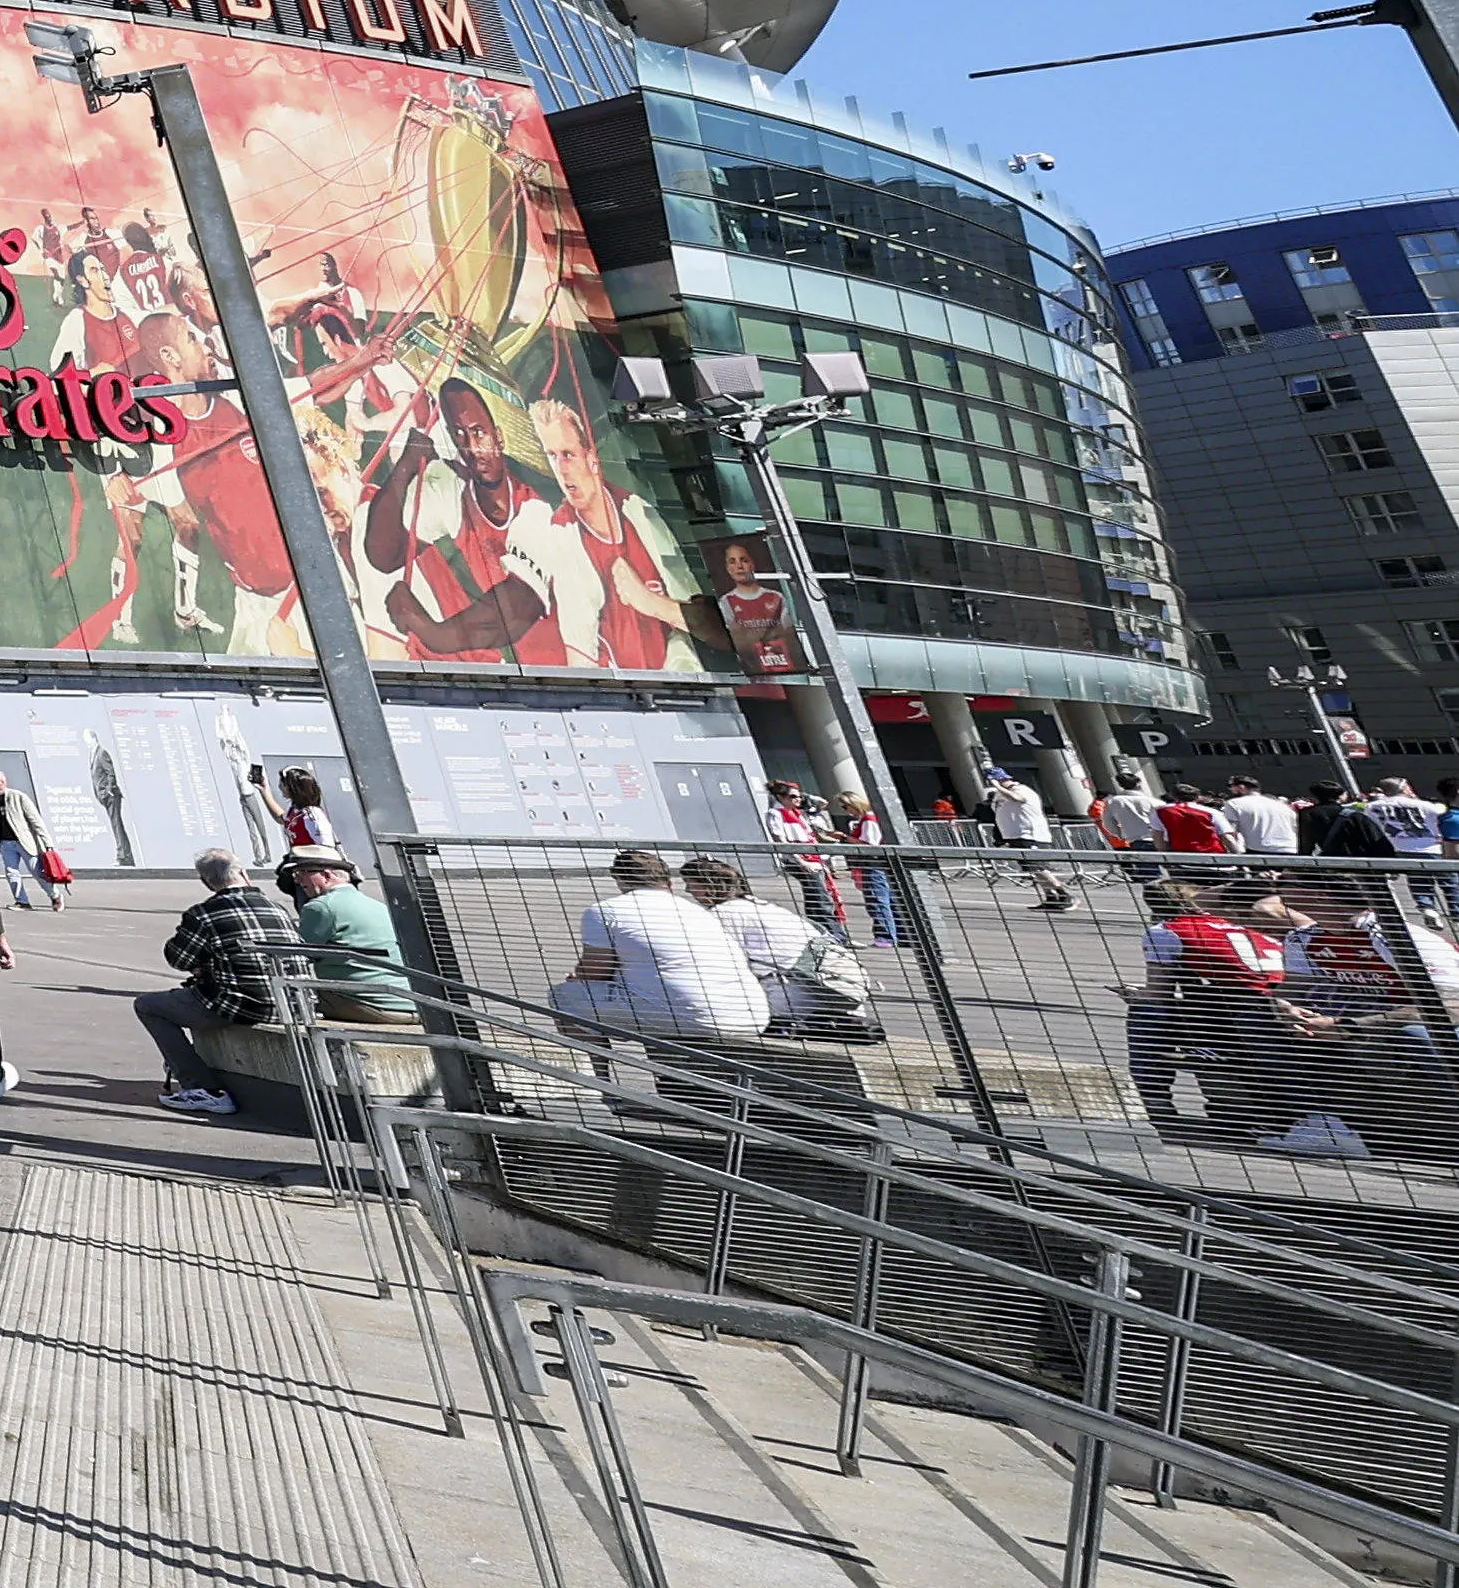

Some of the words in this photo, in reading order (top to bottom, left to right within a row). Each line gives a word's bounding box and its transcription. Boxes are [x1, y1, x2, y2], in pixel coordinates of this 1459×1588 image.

[135, 274, 165, 311] 23
[1003, 718, 1044, 747] R
[1139, 731, 1170, 754] P
